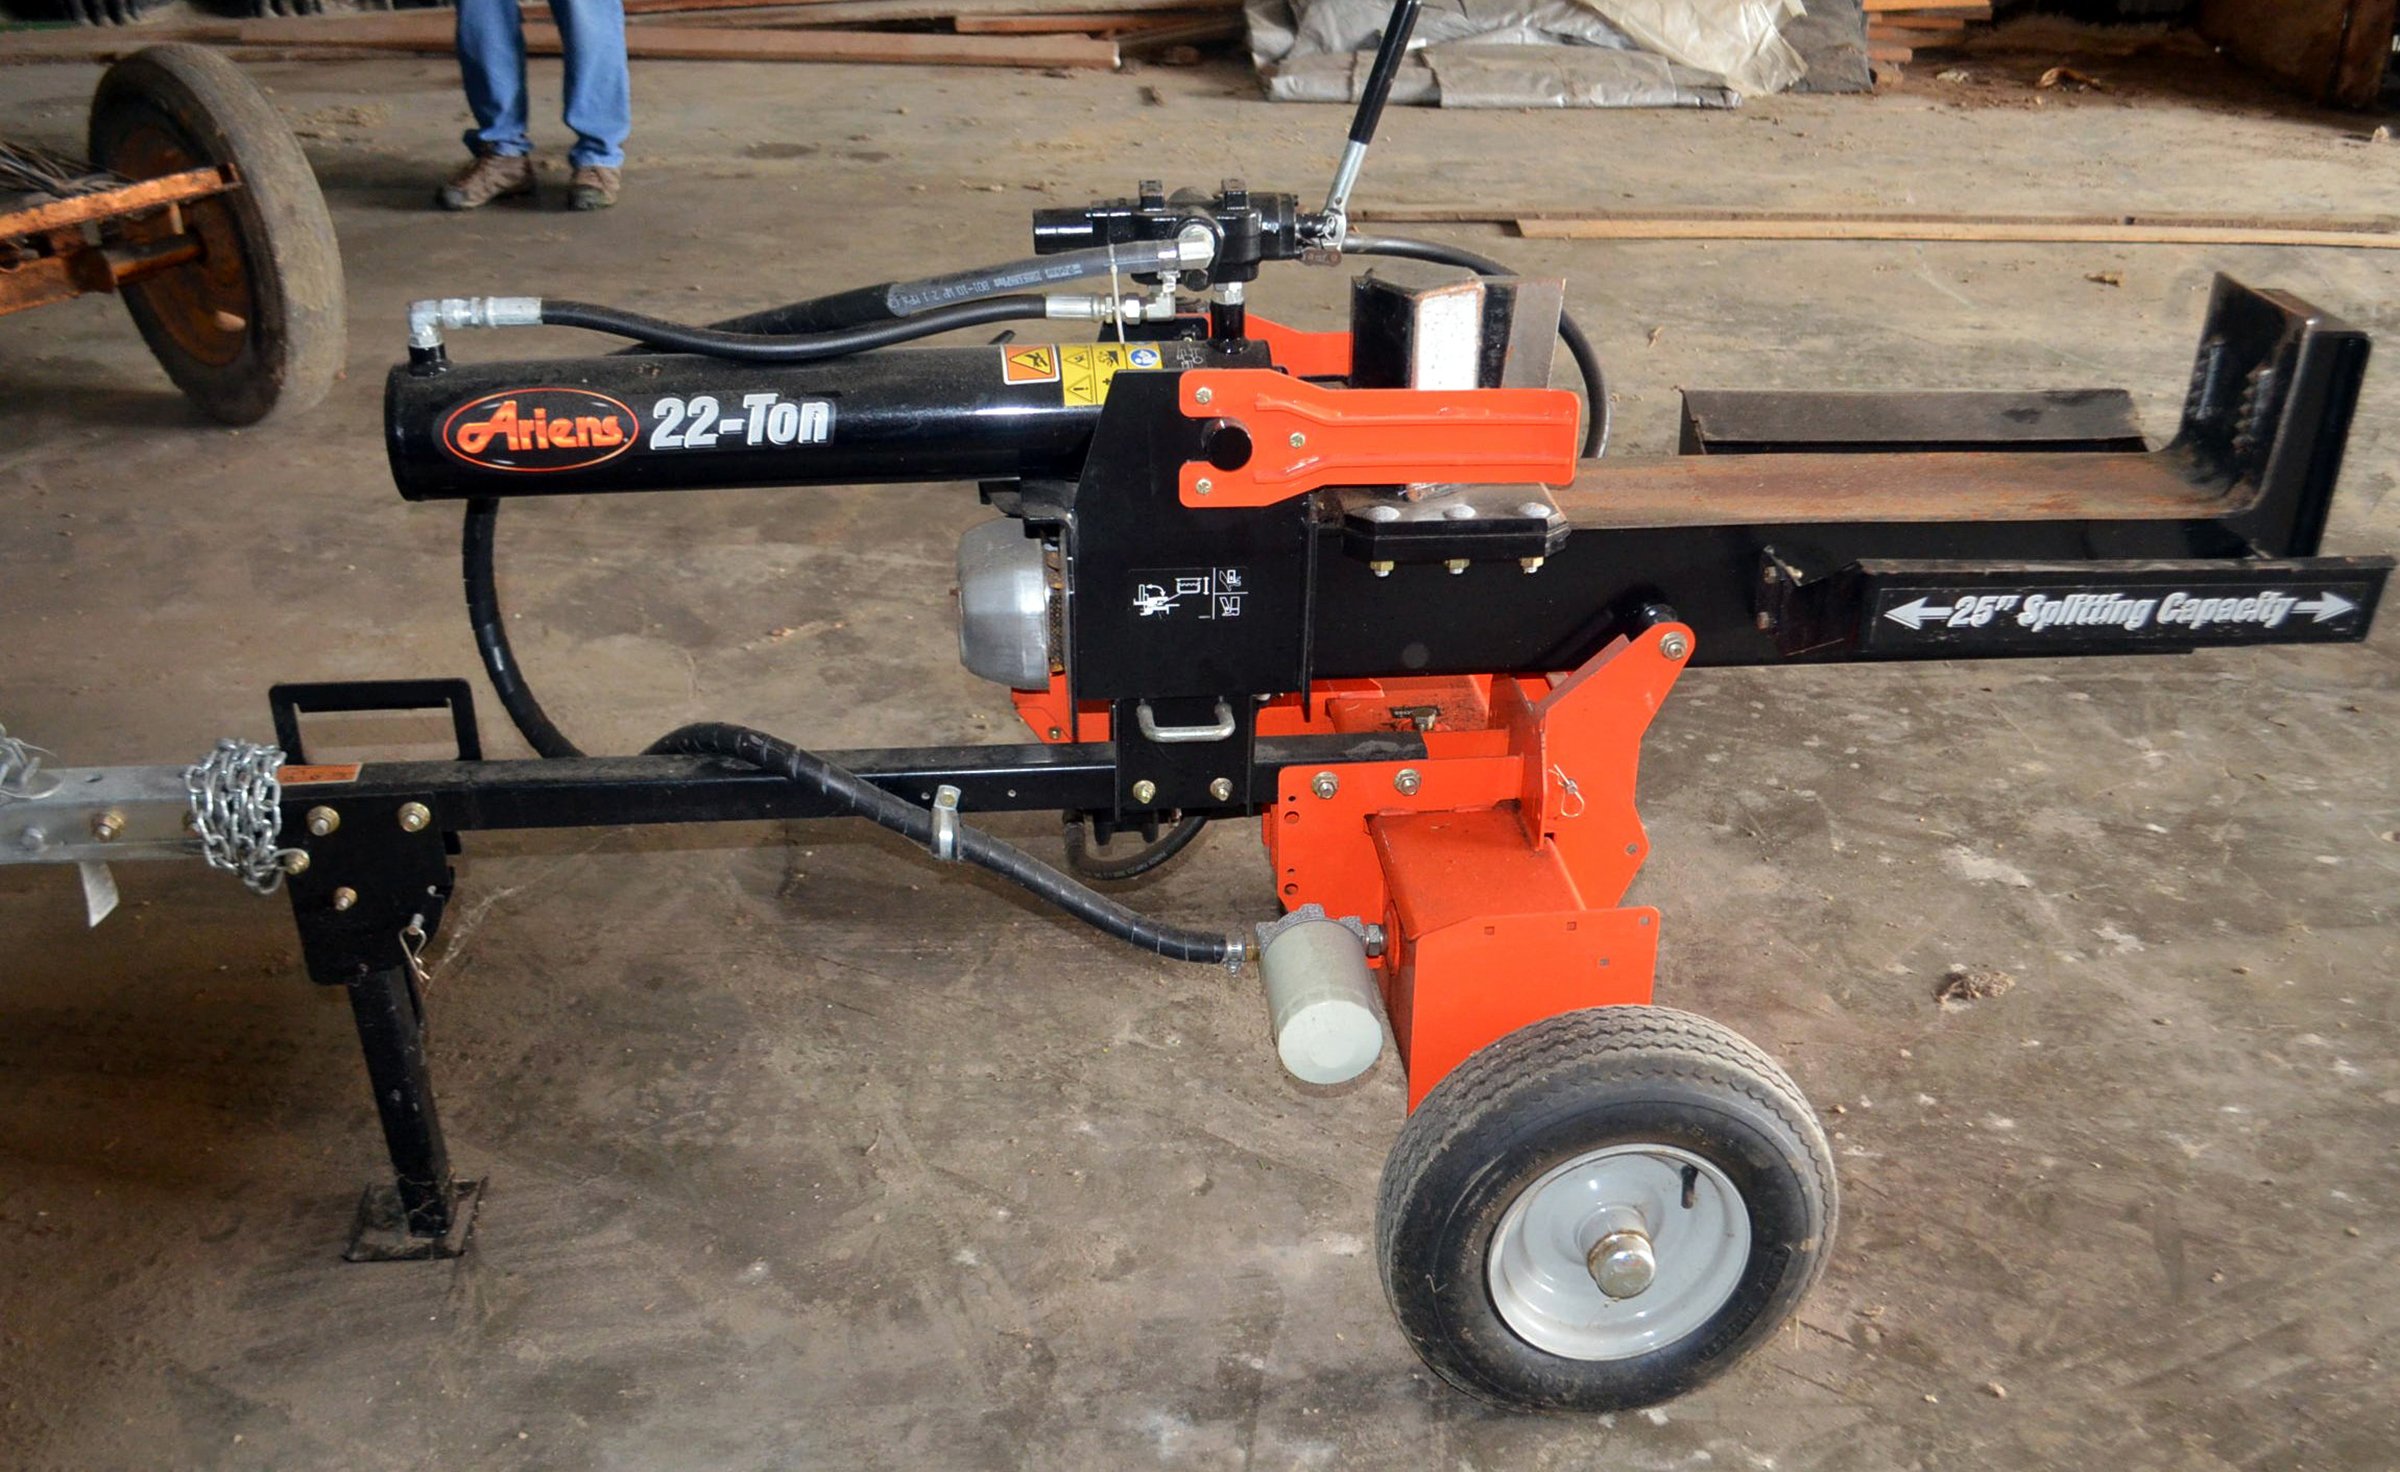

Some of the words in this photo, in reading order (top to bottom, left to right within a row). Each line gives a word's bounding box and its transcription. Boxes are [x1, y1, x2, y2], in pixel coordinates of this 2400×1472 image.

[456, 400, 625, 454] Ariens
[650, 393, 832, 450] 22-Ton
[1947, 594, 2020, 628] 25"
[2017, 593, 2154, 632] Splitting
[2157, 591, 2298, 630] Capacity
